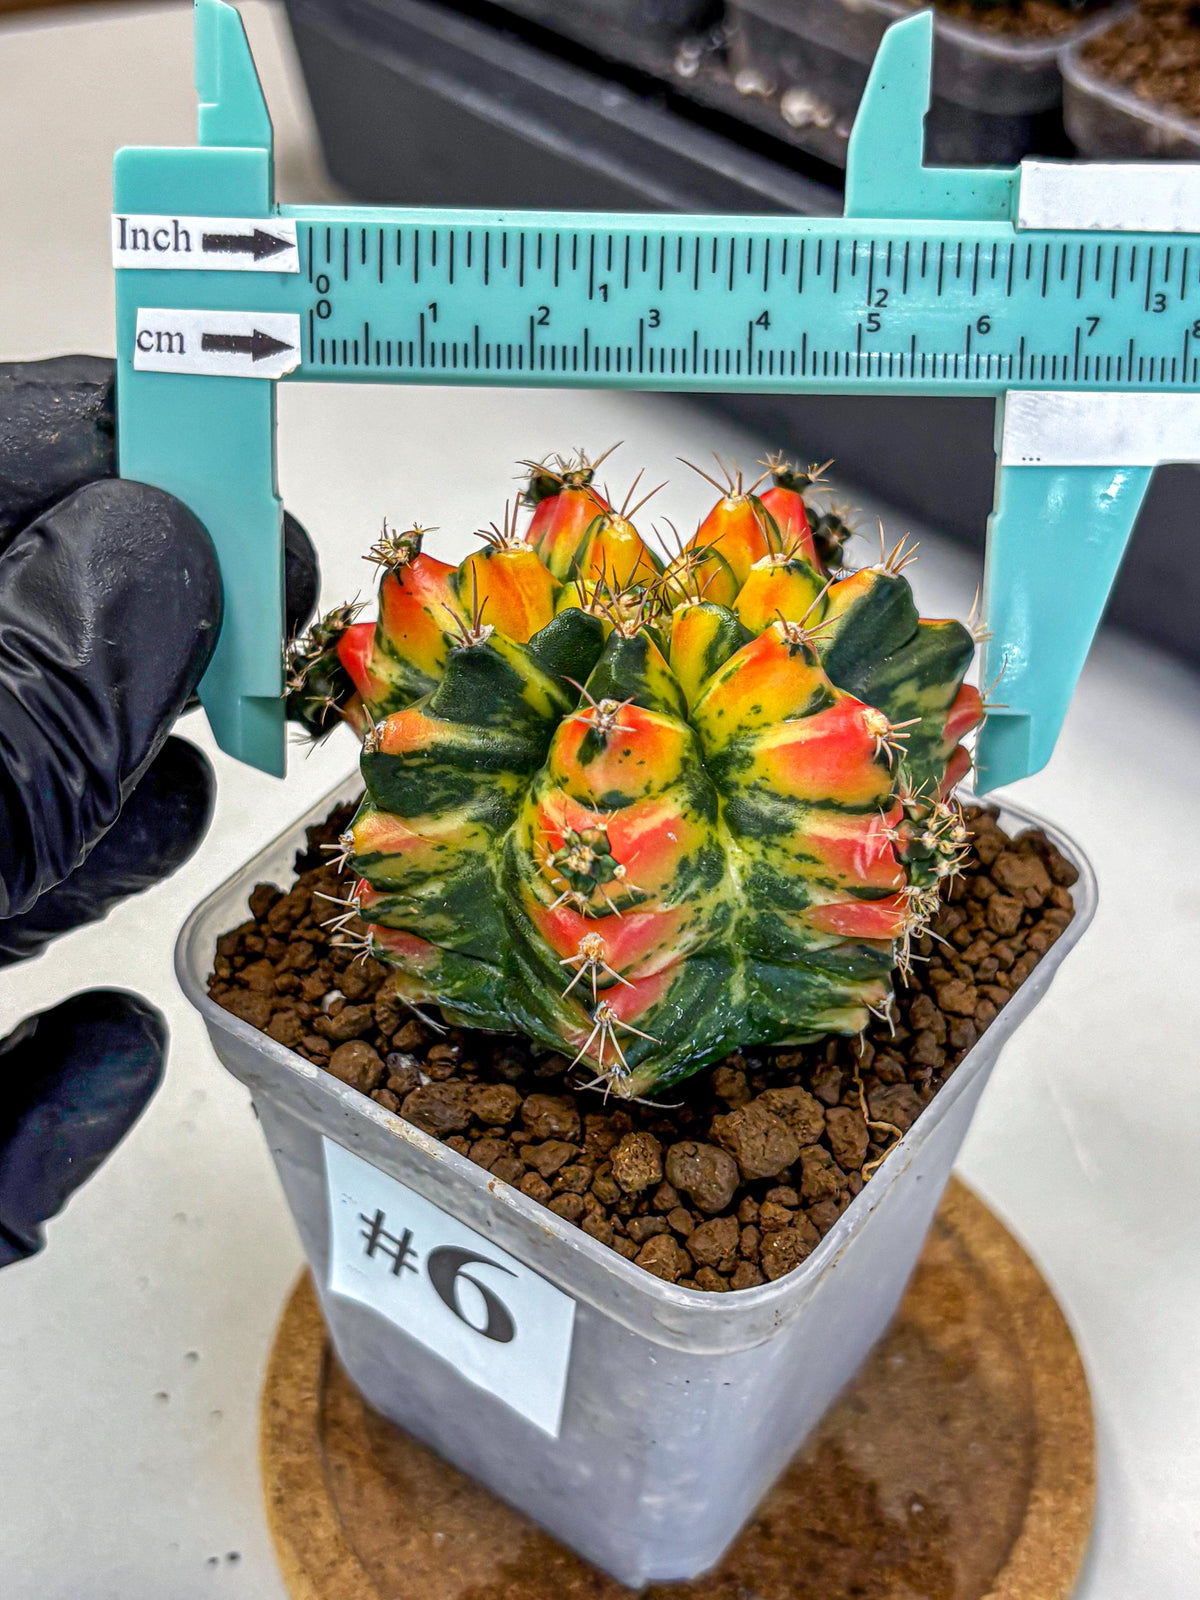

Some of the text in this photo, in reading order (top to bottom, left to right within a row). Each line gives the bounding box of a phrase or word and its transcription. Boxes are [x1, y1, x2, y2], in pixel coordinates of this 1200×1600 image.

[116, 217, 192, 252] Inch
[316, 275, 1167, 313] 0 1 2 3
[316, 300, 332, 319] 0
[428, 302, 438, 323] 1
[537, 306, 550, 326] 2
[648, 309, 661, 328] 3
[755, 311, 771, 331] 4
[866, 313, 881, 333] 5
[976, 315, 991, 335] 6
[1086, 317, 1100, 337] 7
[136, 330, 186, 354] cm
[358, 1208, 520, 1343] #6
